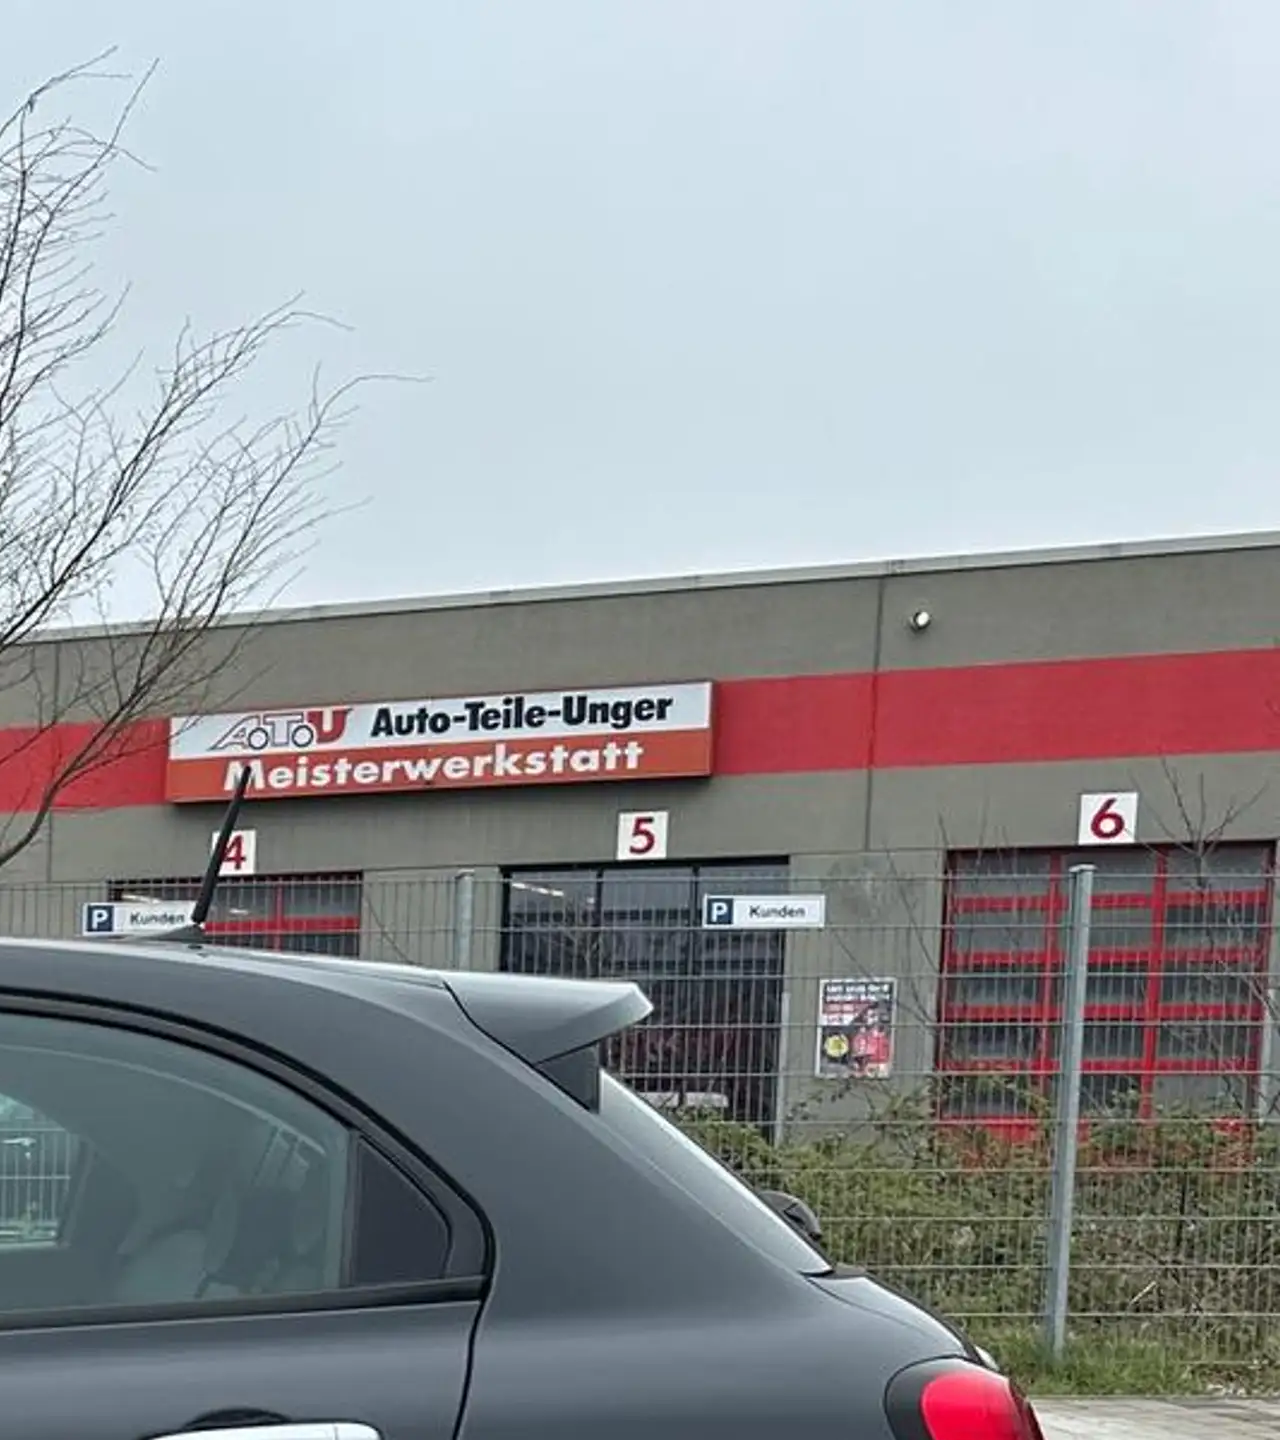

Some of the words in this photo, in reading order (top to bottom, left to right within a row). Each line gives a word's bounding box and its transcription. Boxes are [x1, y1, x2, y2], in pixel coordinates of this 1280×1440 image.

[370, 696, 672, 738] Auto-Teile-Unger
[224, 742, 644, 791] Meisterwerkstatt
[629, 817, 655, 854] 5
[1091, 798, 1125, 839] 6
[220, 836, 246, 870] 4
[130, 911, 185, 925] Kunden
[749, 905, 806, 918] Kunden
